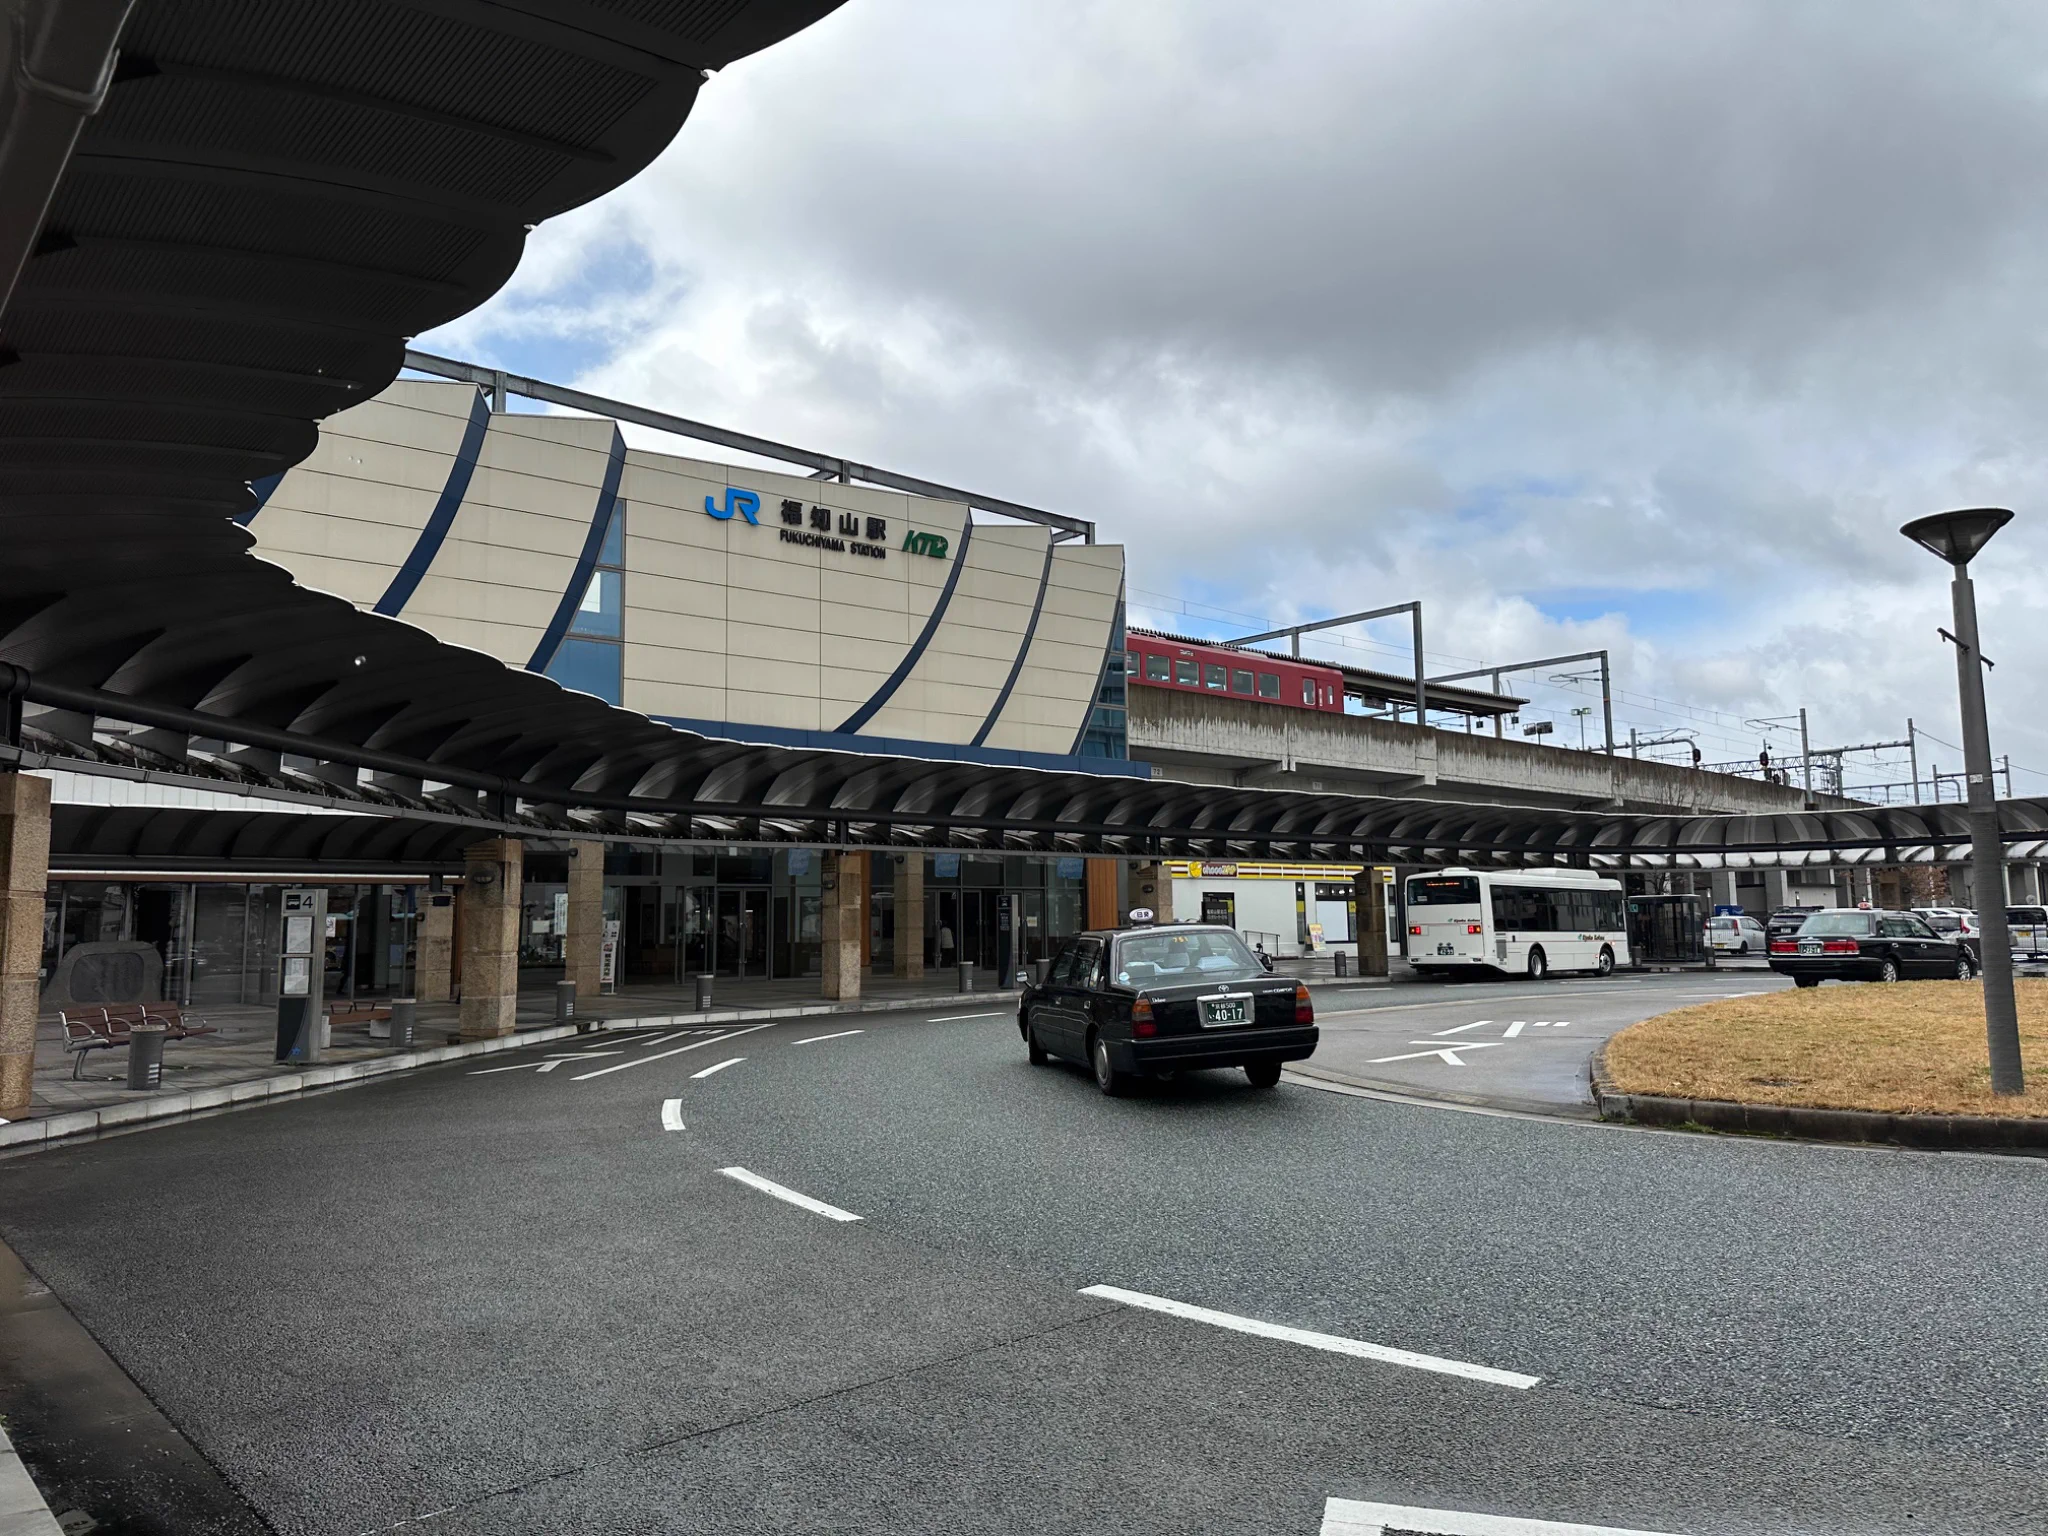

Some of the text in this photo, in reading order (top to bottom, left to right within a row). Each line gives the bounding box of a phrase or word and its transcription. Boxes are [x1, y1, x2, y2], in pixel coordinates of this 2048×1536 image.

[705, 487, 761, 525] JR
[781, 499, 886, 540] 福知山駅
[780, 529, 886, 559] FUKUCHIYAMA STATION
[902, 529, 949, 559] KTR
[302, 896, 313, 909] 4
[1215, 1008, 1243, 1021] 40-17
